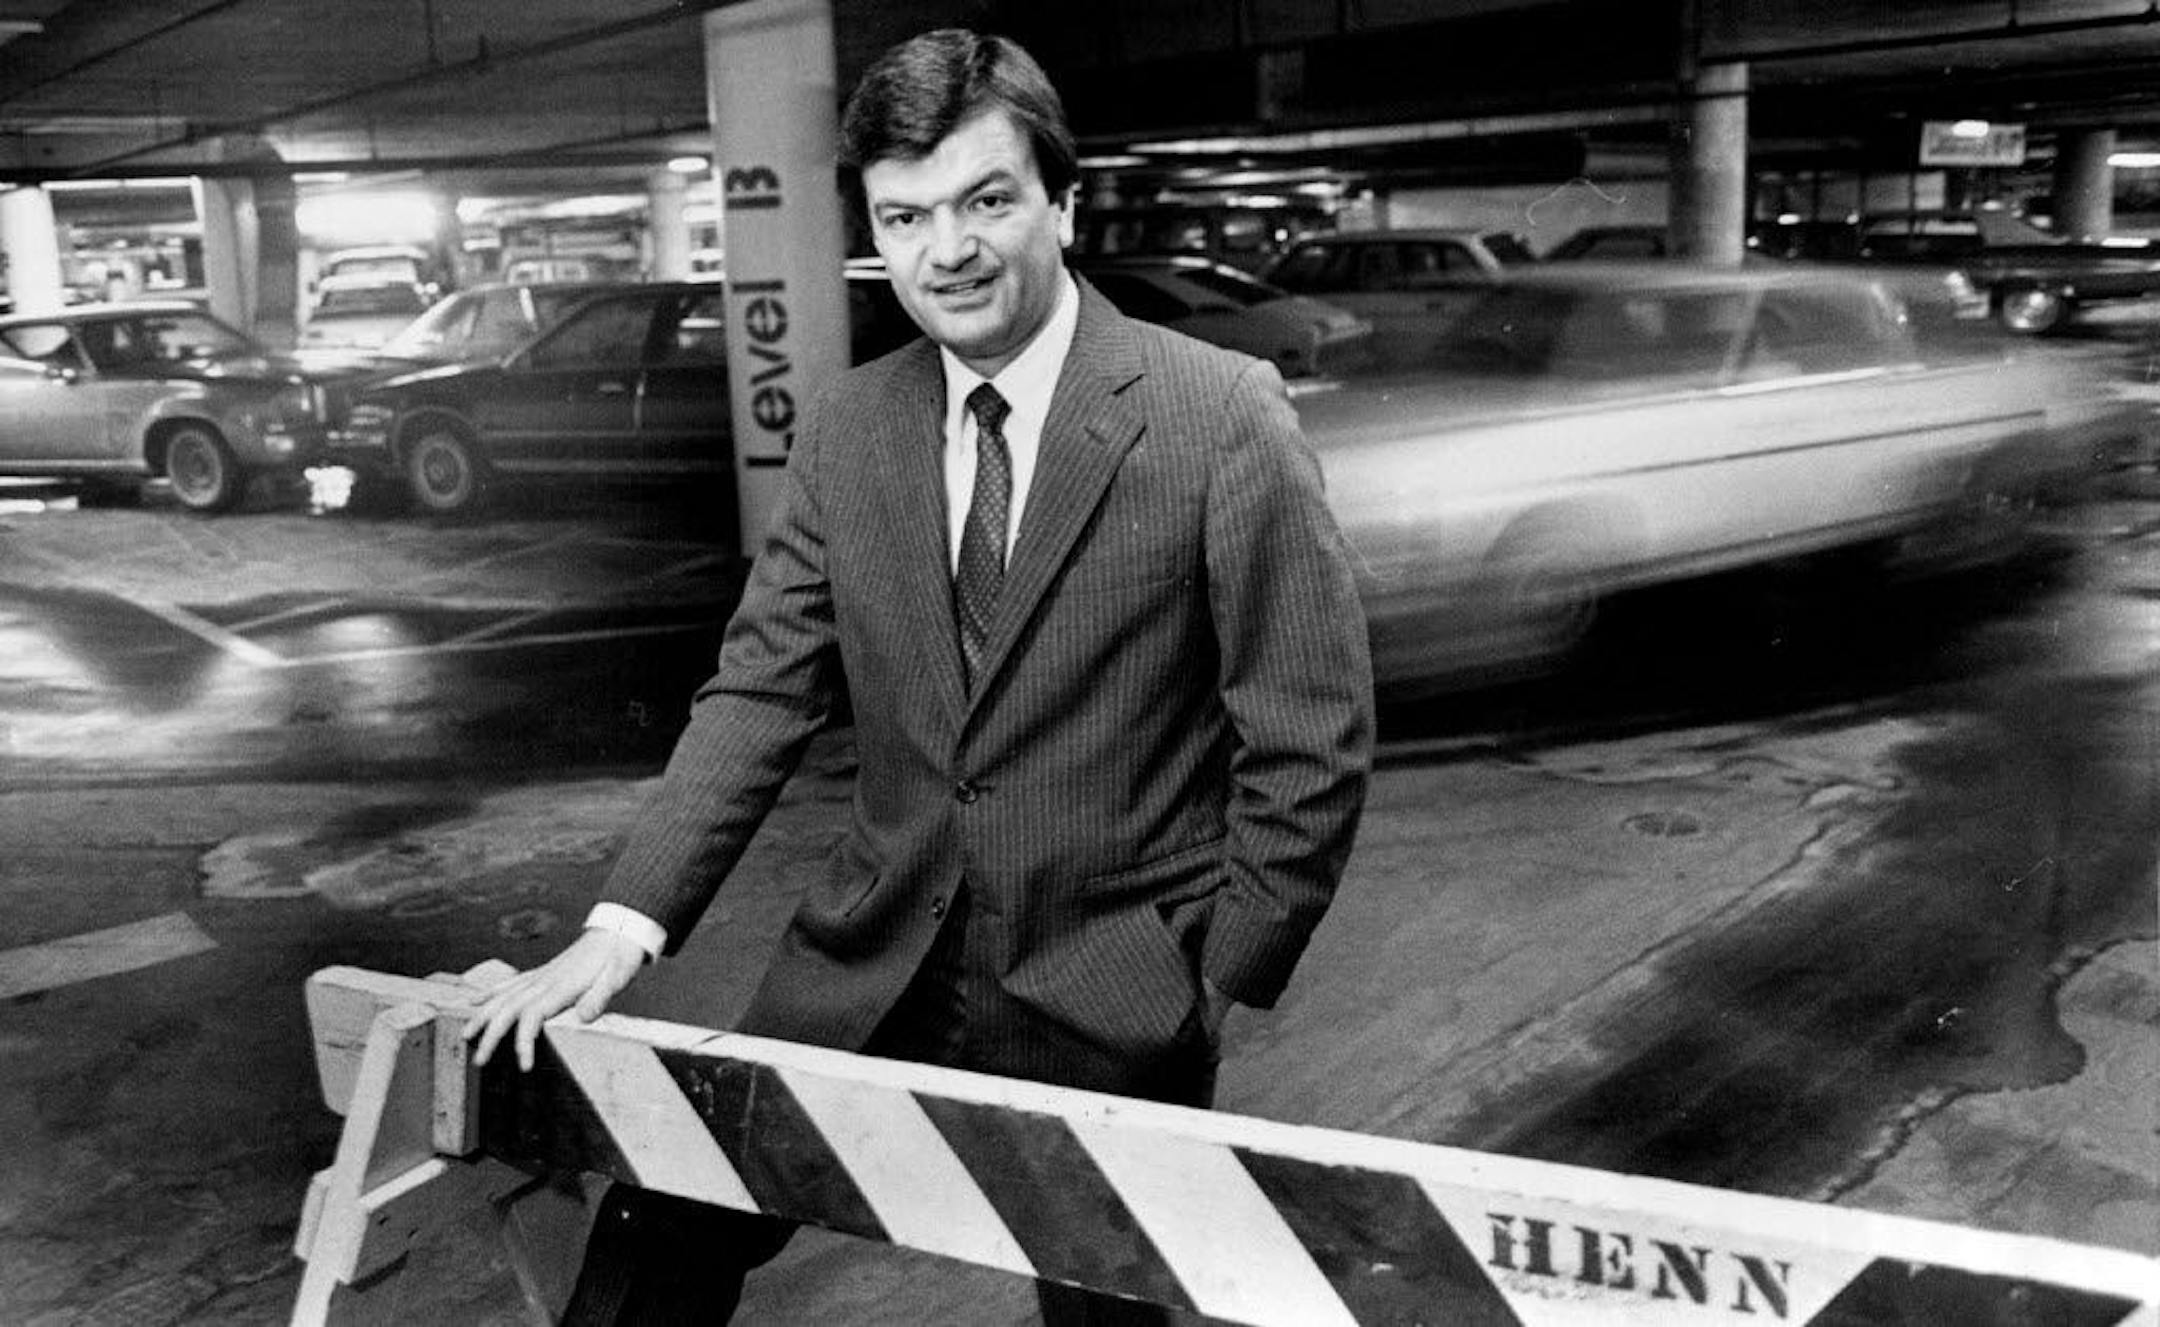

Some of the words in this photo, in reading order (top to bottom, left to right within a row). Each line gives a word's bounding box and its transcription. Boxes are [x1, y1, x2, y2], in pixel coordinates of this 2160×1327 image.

[726, 166, 781, 210] B
[732, 280, 795, 467] Level
[1486, 1212, 1792, 1318] HENN
